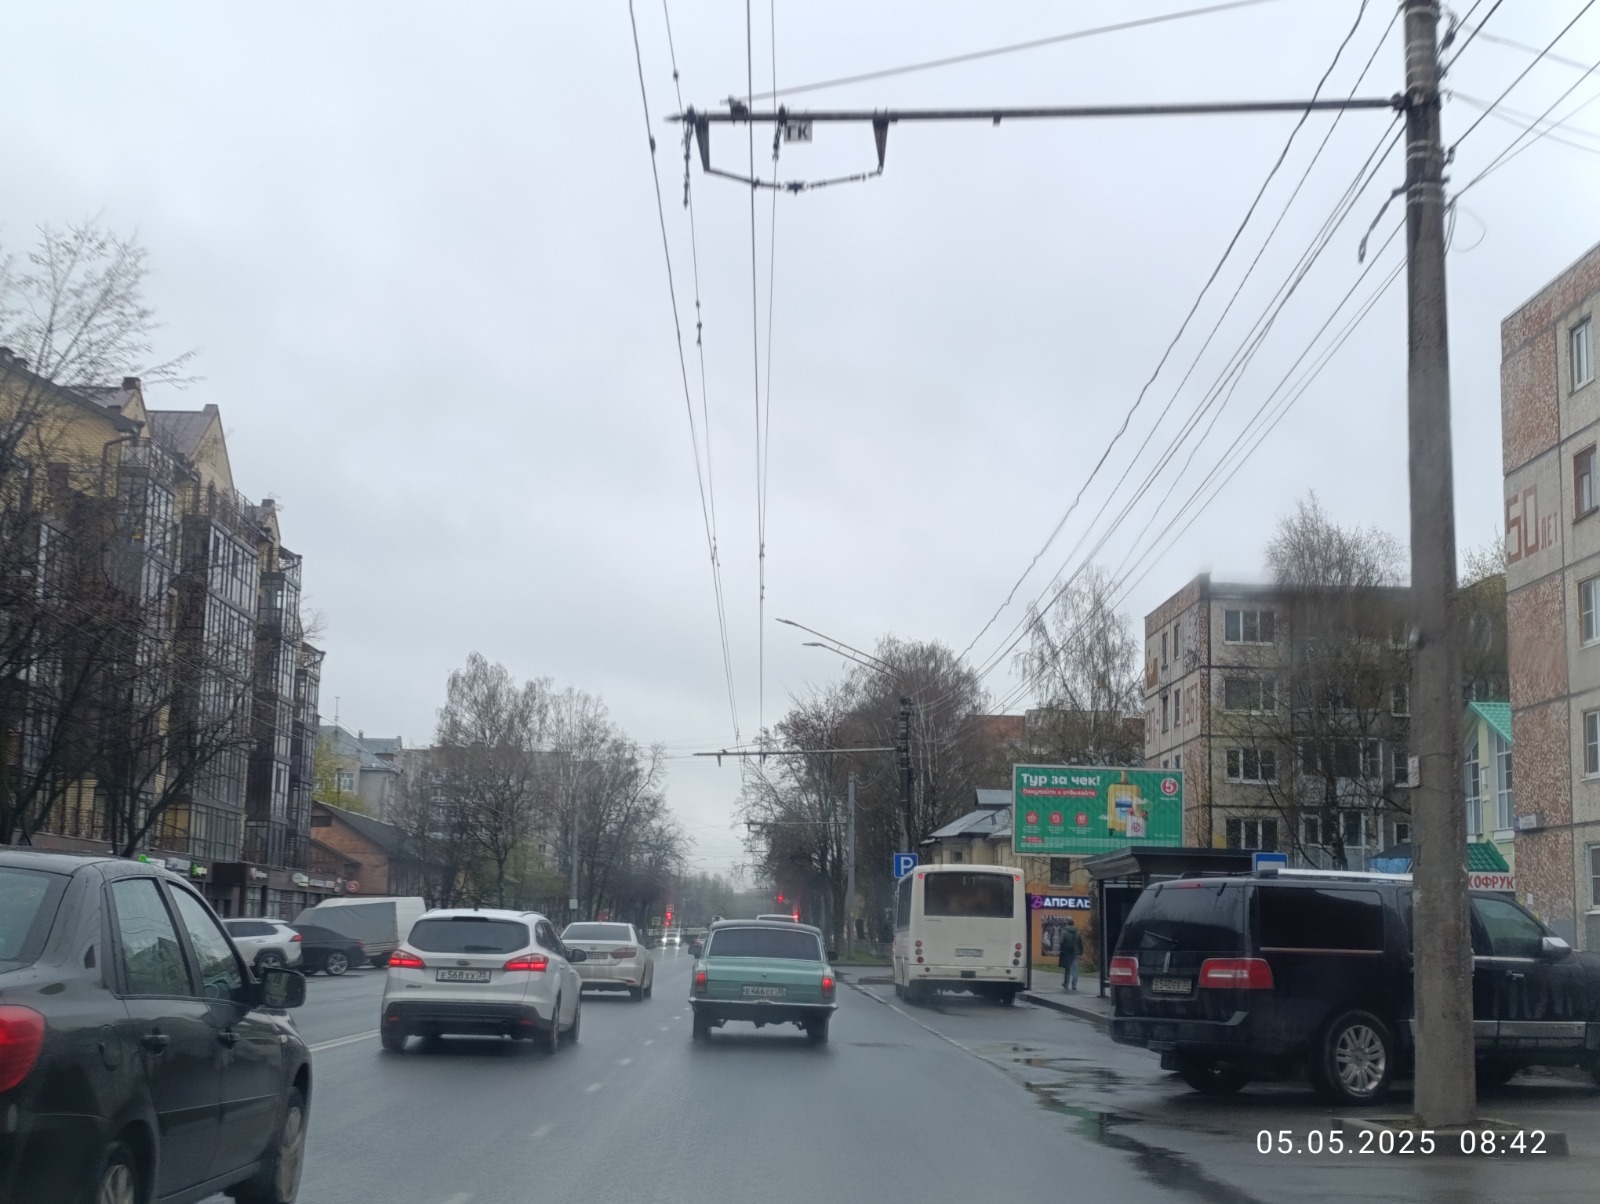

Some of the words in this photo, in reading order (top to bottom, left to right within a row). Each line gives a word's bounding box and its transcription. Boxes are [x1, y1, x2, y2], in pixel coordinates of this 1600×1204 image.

[1506, 483, 1540, 566] 50
[1021, 772, 1048, 787] Тур
[1051, 774, 1068, 785] за
[1071, 774, 1100, 786] чек!
[1022, 788, 1057, 797] Покупайте
[900, 856, 914, 876] P
[1468, 874, 1515, 889] КОФРУК
[1043, 897, 1091, 908] АПРЕЛЬ
